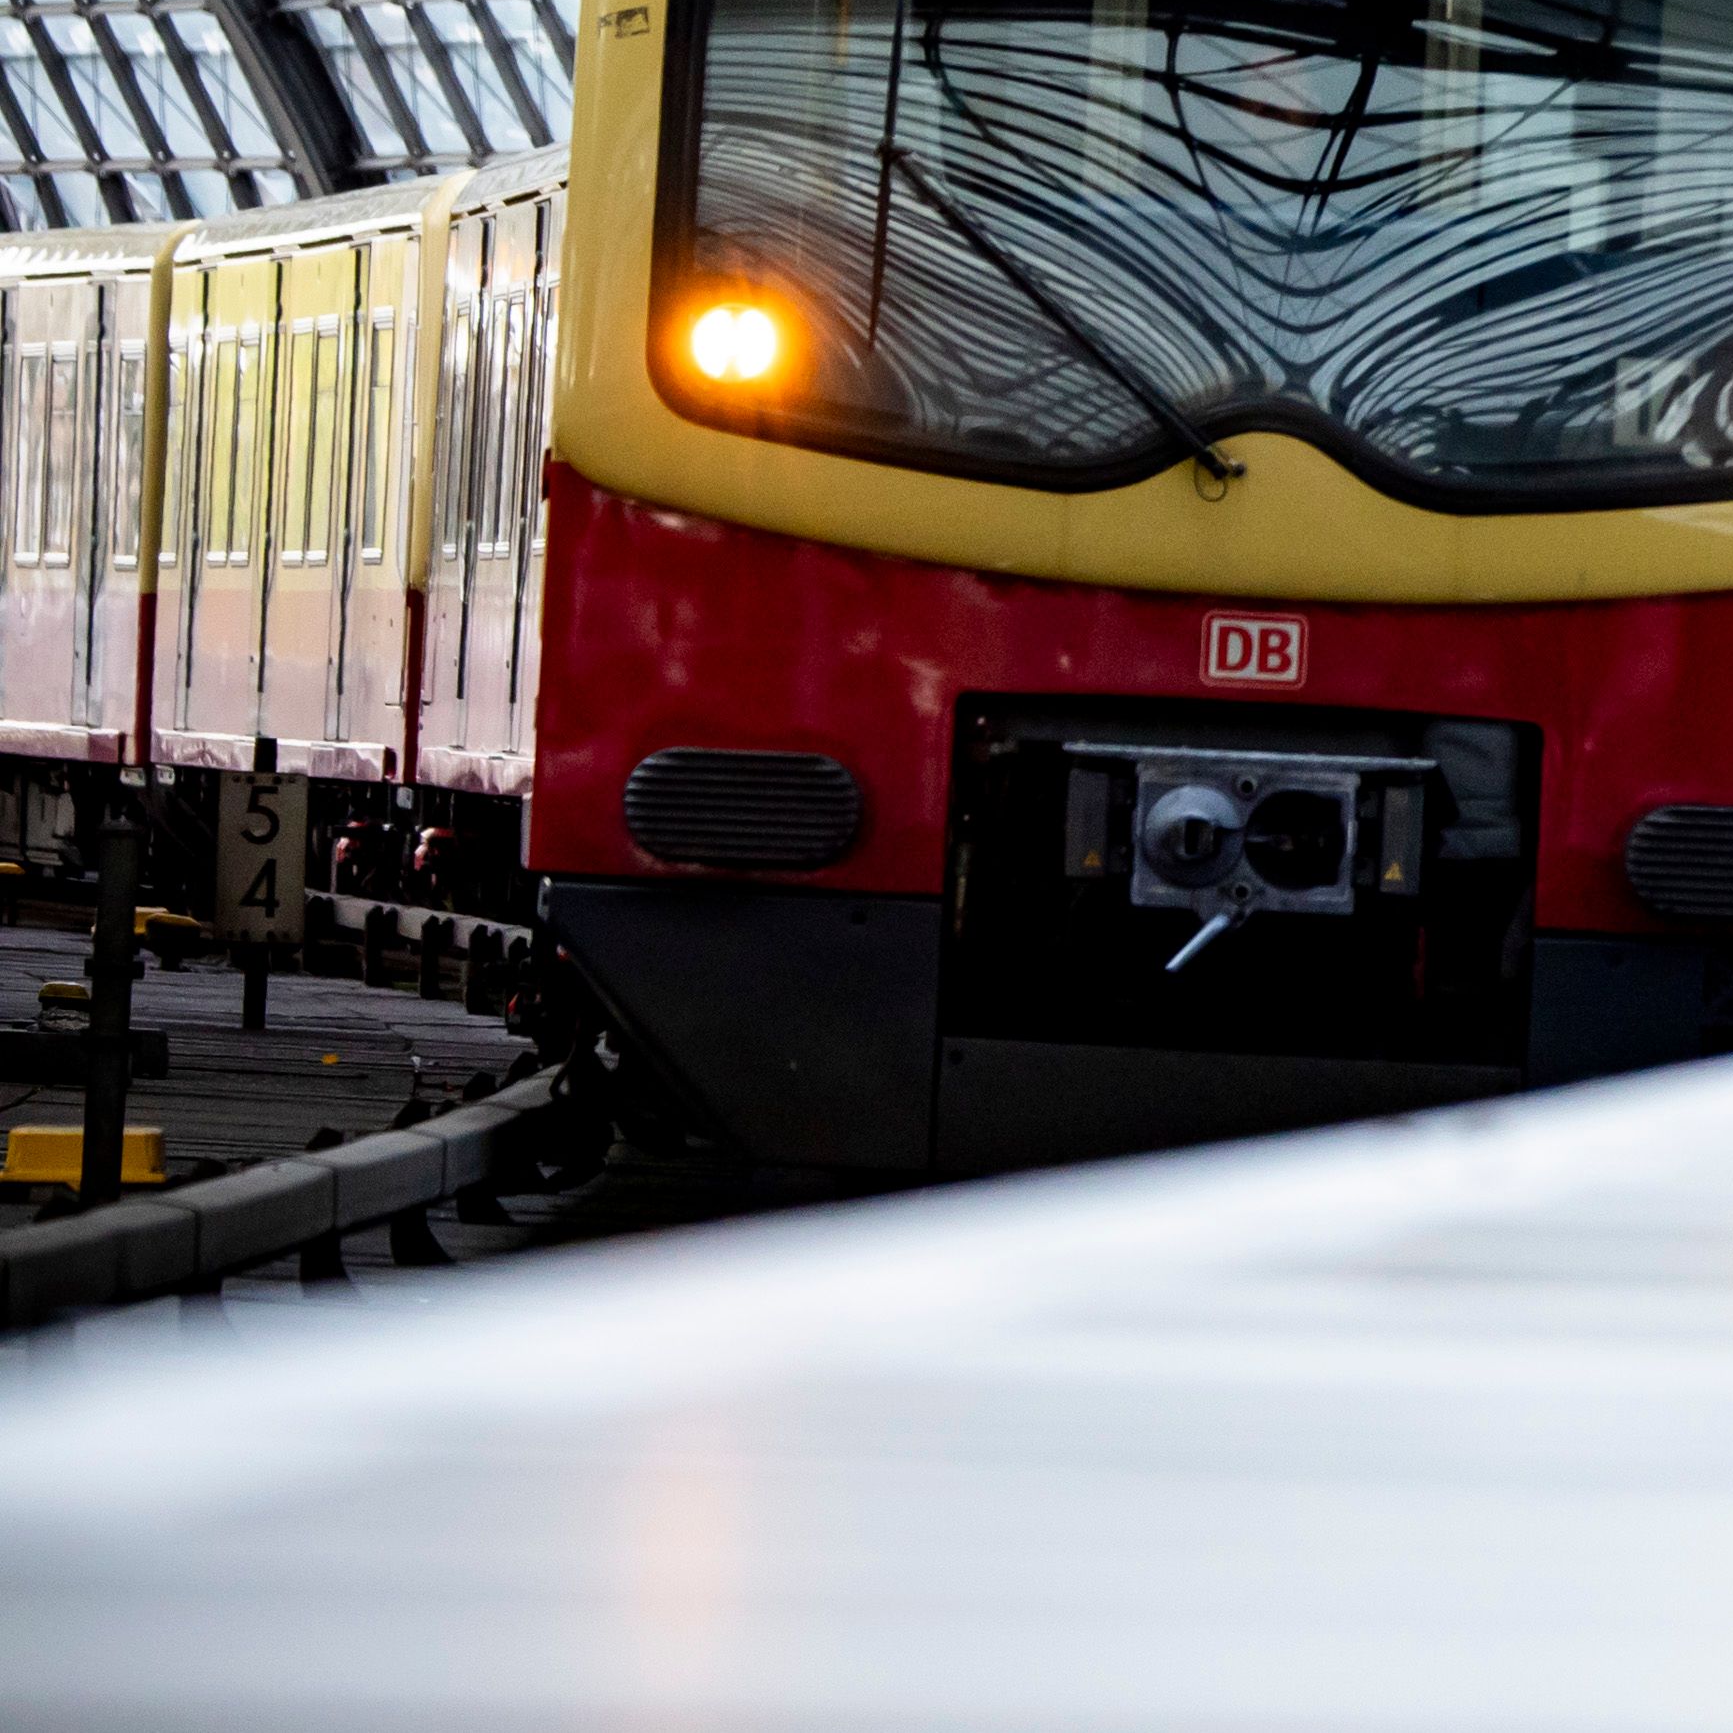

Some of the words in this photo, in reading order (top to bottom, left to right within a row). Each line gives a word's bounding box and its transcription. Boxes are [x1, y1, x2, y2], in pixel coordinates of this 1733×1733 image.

[1217, 625, 1293, 674] DB
[240, 784, 281, 846] 5
[239, 857, 281, 918] 4
